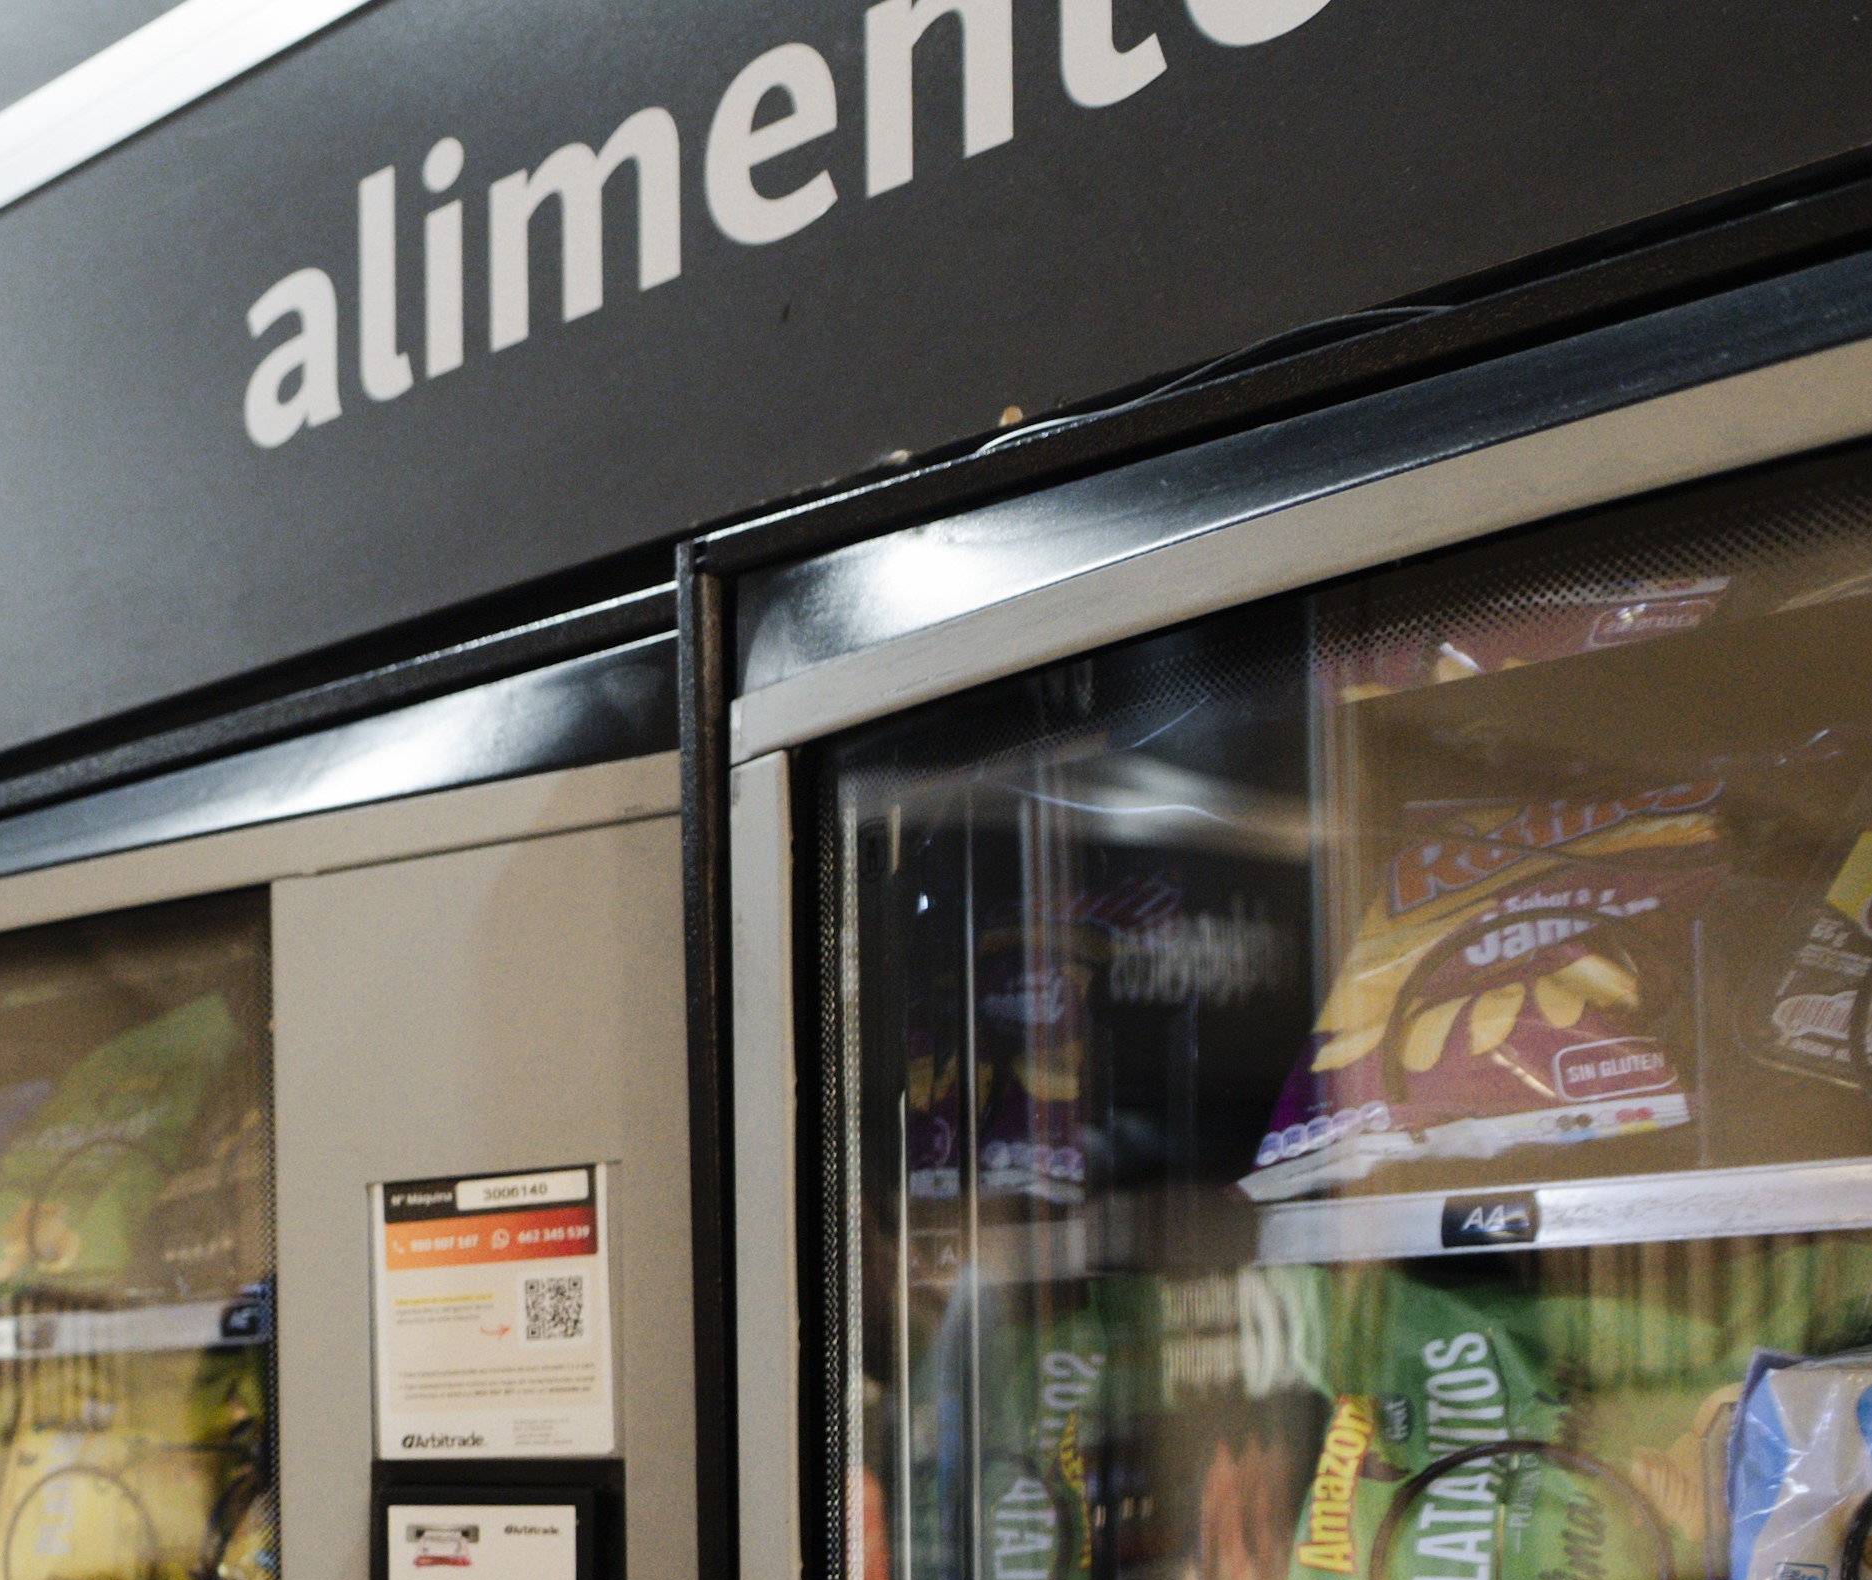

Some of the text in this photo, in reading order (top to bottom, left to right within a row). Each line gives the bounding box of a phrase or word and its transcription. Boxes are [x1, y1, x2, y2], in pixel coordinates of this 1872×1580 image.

[245, 0, 1335, 448] alimen
[1567, 1051, 1665, 1084] SIN GLUTEN
[1297, 1396, 1374, 1575] Amazon
